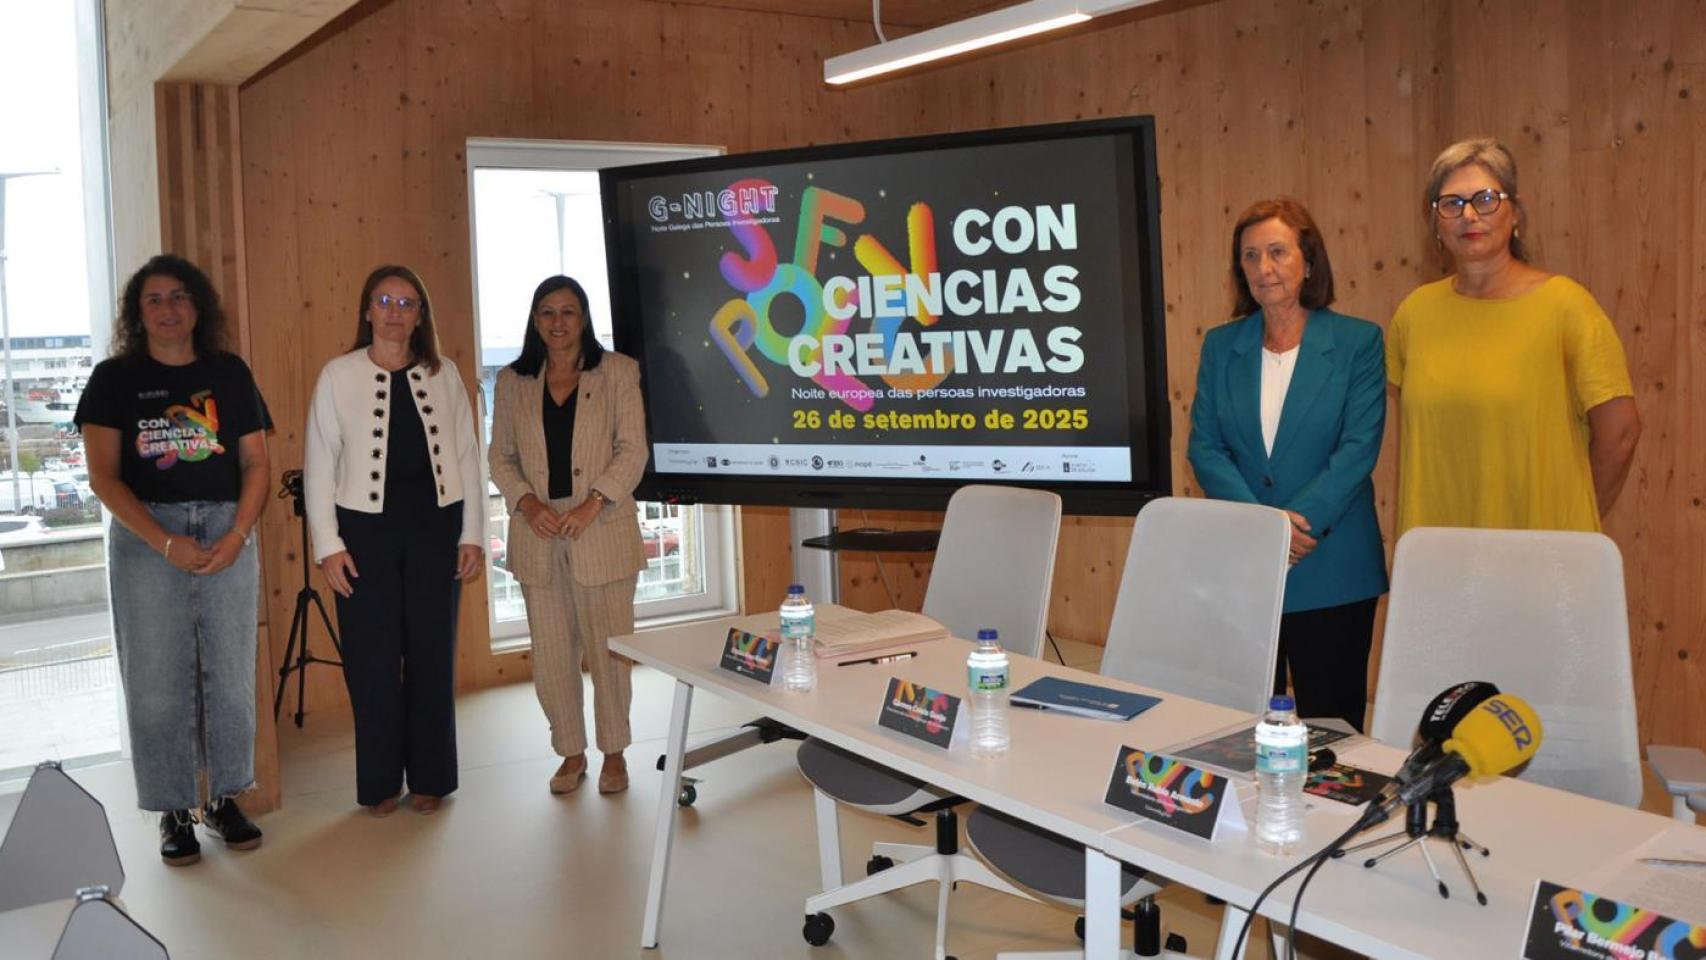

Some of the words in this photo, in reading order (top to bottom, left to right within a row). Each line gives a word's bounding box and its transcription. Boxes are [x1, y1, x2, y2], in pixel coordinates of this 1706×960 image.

[648, 185, 779, 222] G-NIGHT
[952, 203, 1078, 257] CON
[822, 265, 1082, 320] CIENCIAS
[787, 326, 1086, 378] CREATIVAS
[791, 387, 826, 399] Noite
[828, 389, 884, 401] europea
[887, 386, 913, 399] das
[916, 388, 975, 402] persoas
[978, 385, 1086, 402] investigadoras
[138, 418, 169, 429] CON
[139, 427, 207, 441] CIENCIAS
[792, 410, 821, 429] 26
[828, 409, 856, 430] de
[863, 409, 976, 430] setembro
[984, 408, 1015, 430] de
[1023, 409, 1089, 430] 2025
[1482, 698, 1533, 752] SER
[1554, 921, 1585, 938] Pilar
[1586, 931, 1647, 960] Bermejo
